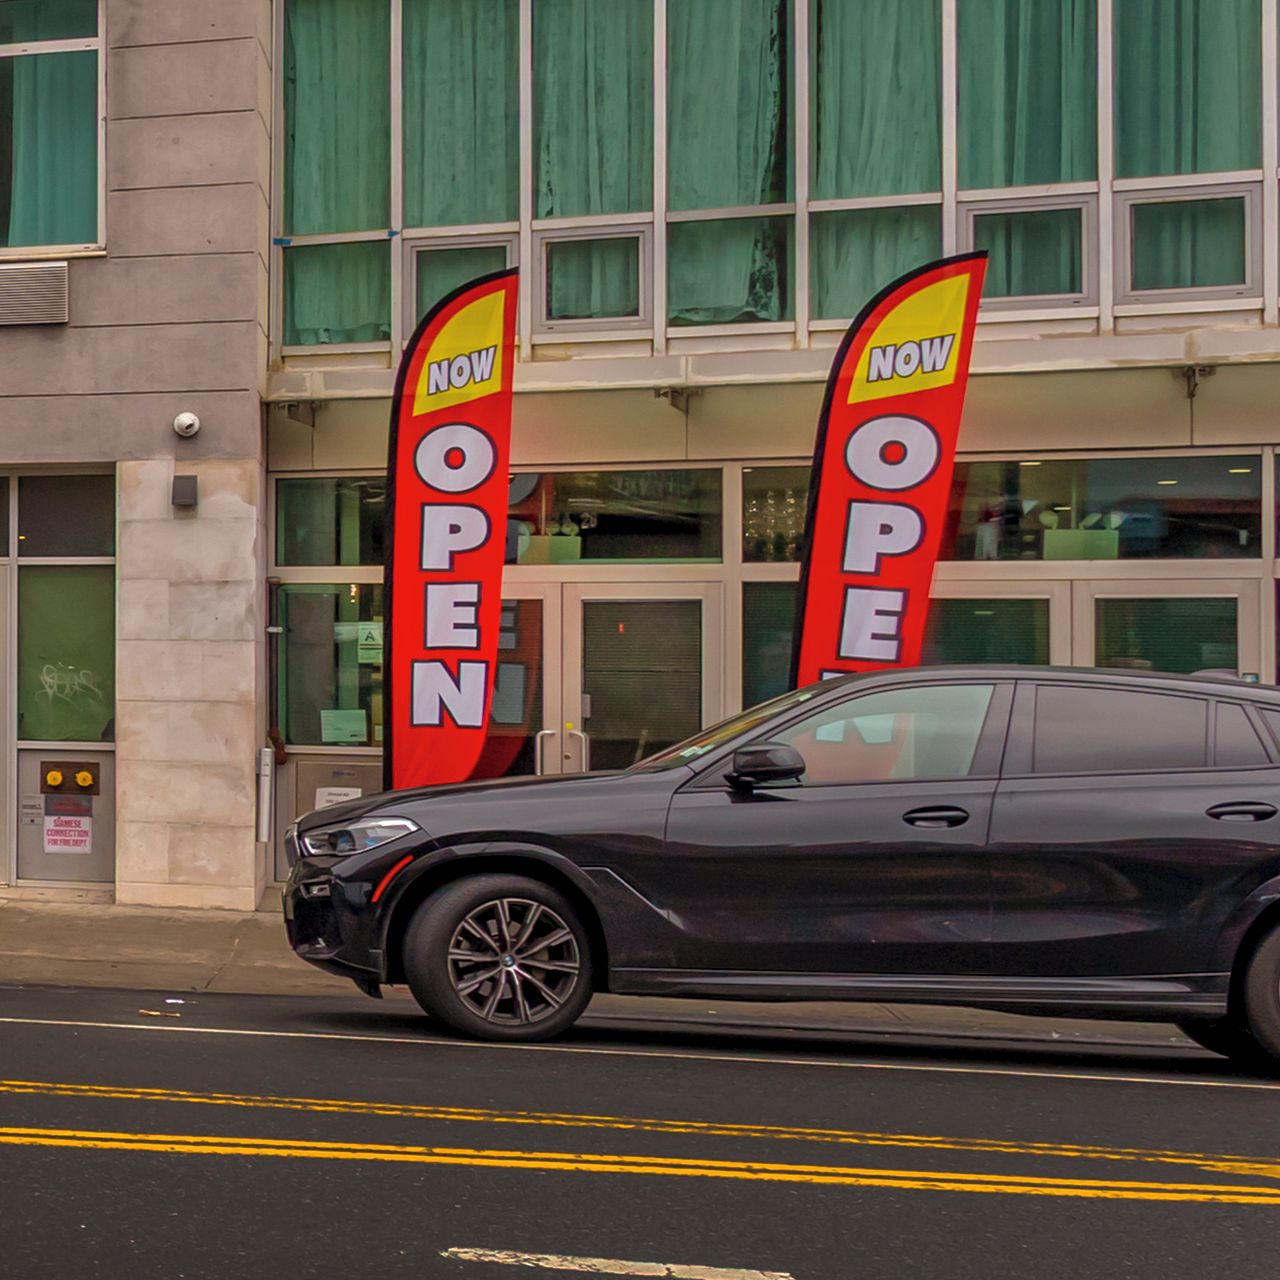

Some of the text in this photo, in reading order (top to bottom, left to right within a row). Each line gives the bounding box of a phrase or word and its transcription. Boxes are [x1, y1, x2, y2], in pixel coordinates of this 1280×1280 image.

[427, 344, 498, 396] NOW
[866, 333, 956, 383] NOW
[410, 422, 497, 728] OPEN
[364, 630, 375, 642] A
[47, 829, 89, 838] CONNECTION
[48, 838, 58, 846] FOR
